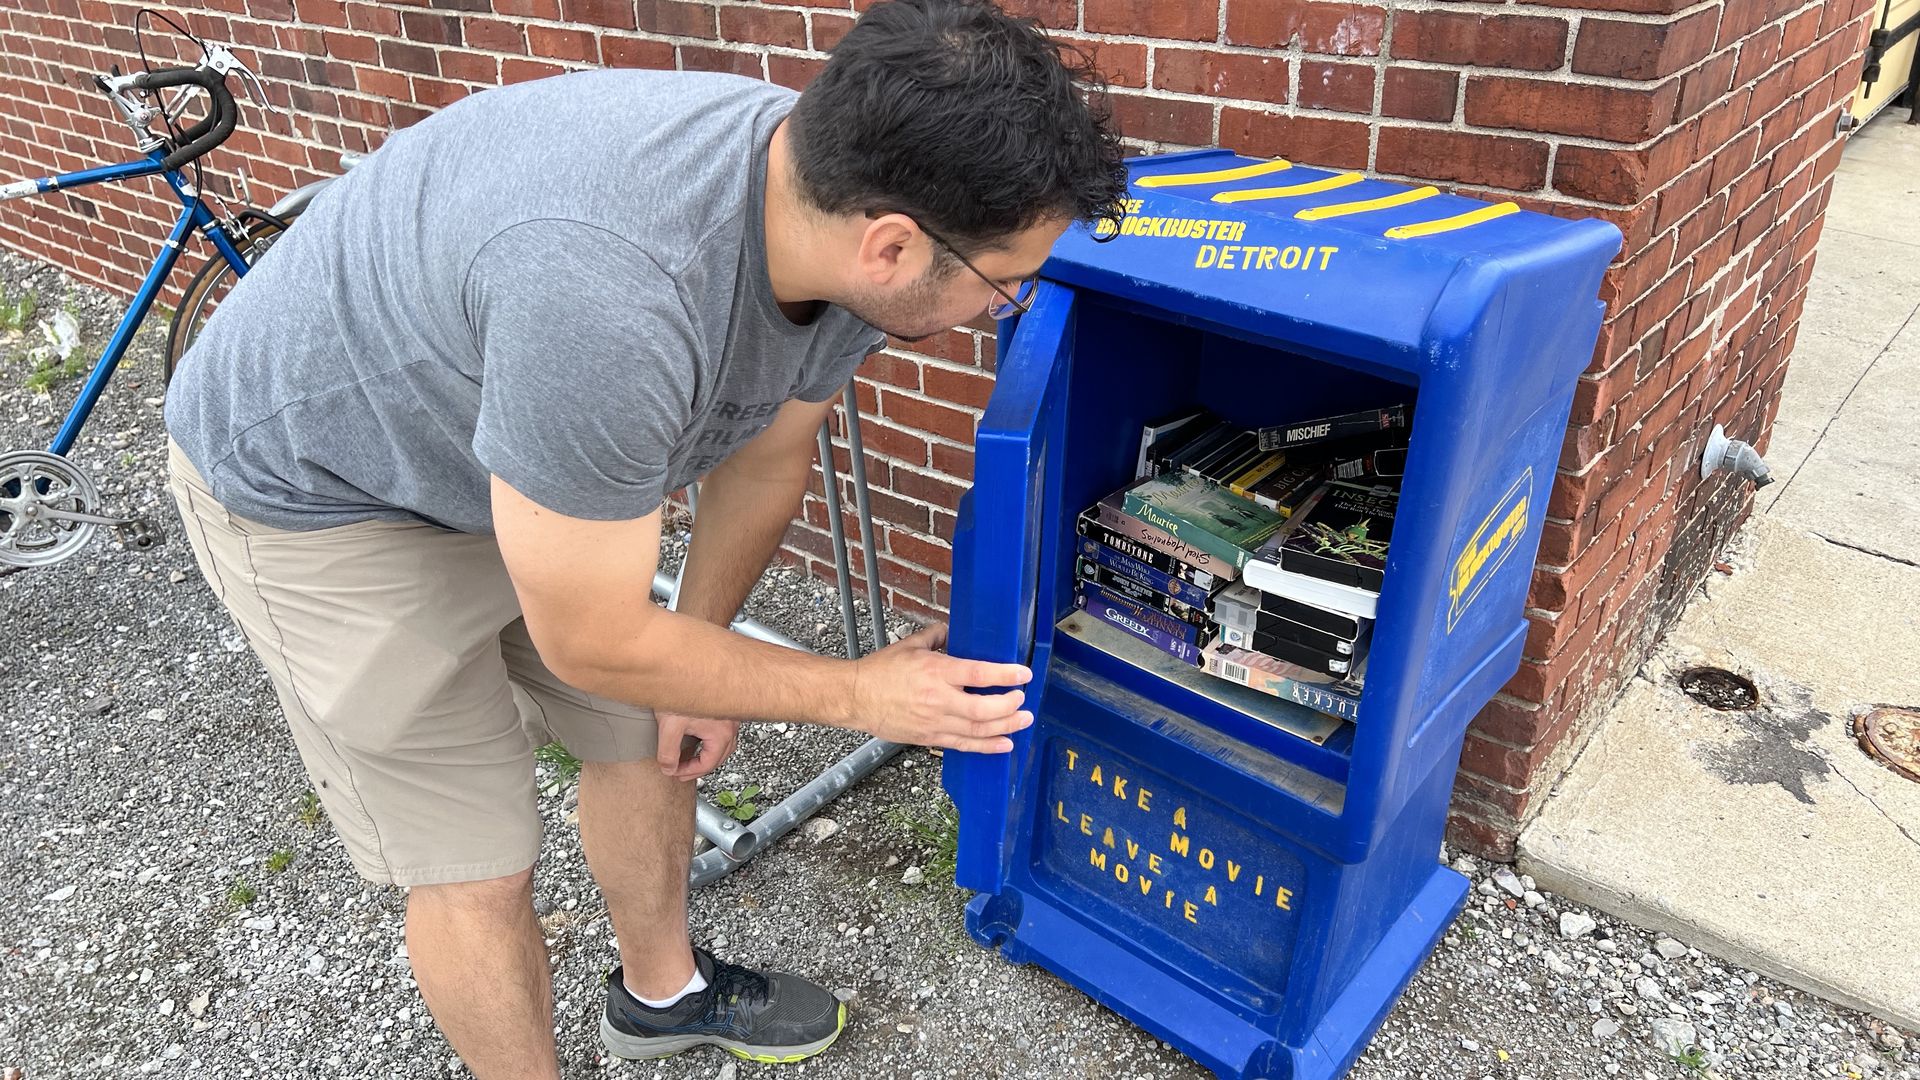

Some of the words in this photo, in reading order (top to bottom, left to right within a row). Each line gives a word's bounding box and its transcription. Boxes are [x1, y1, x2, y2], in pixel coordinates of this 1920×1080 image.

[1195, 244, 1338, 271] DETROIT
[1286, 423, 1331, 443] MISCHIEF
[1274, 473, 1296, 490] BIG
[1136, 503, 1179, 537] Maurice
[1103, 532, 1154, 564] TOMBSTONE
[1104, 607, 1151, 638] GREEDY
[1292, 683, 1358, 718] TUCKER
[1066, 749, 1153, 812] TAKE
[1172, 807, 1187, 830] A
[1057, 800, 1163, 875] LEAVE
[1204, 885, 1217, 906] A
[1090, 847, 1199, 924] MOVIE
[1170, 832, 1293, 911] MOVIE
